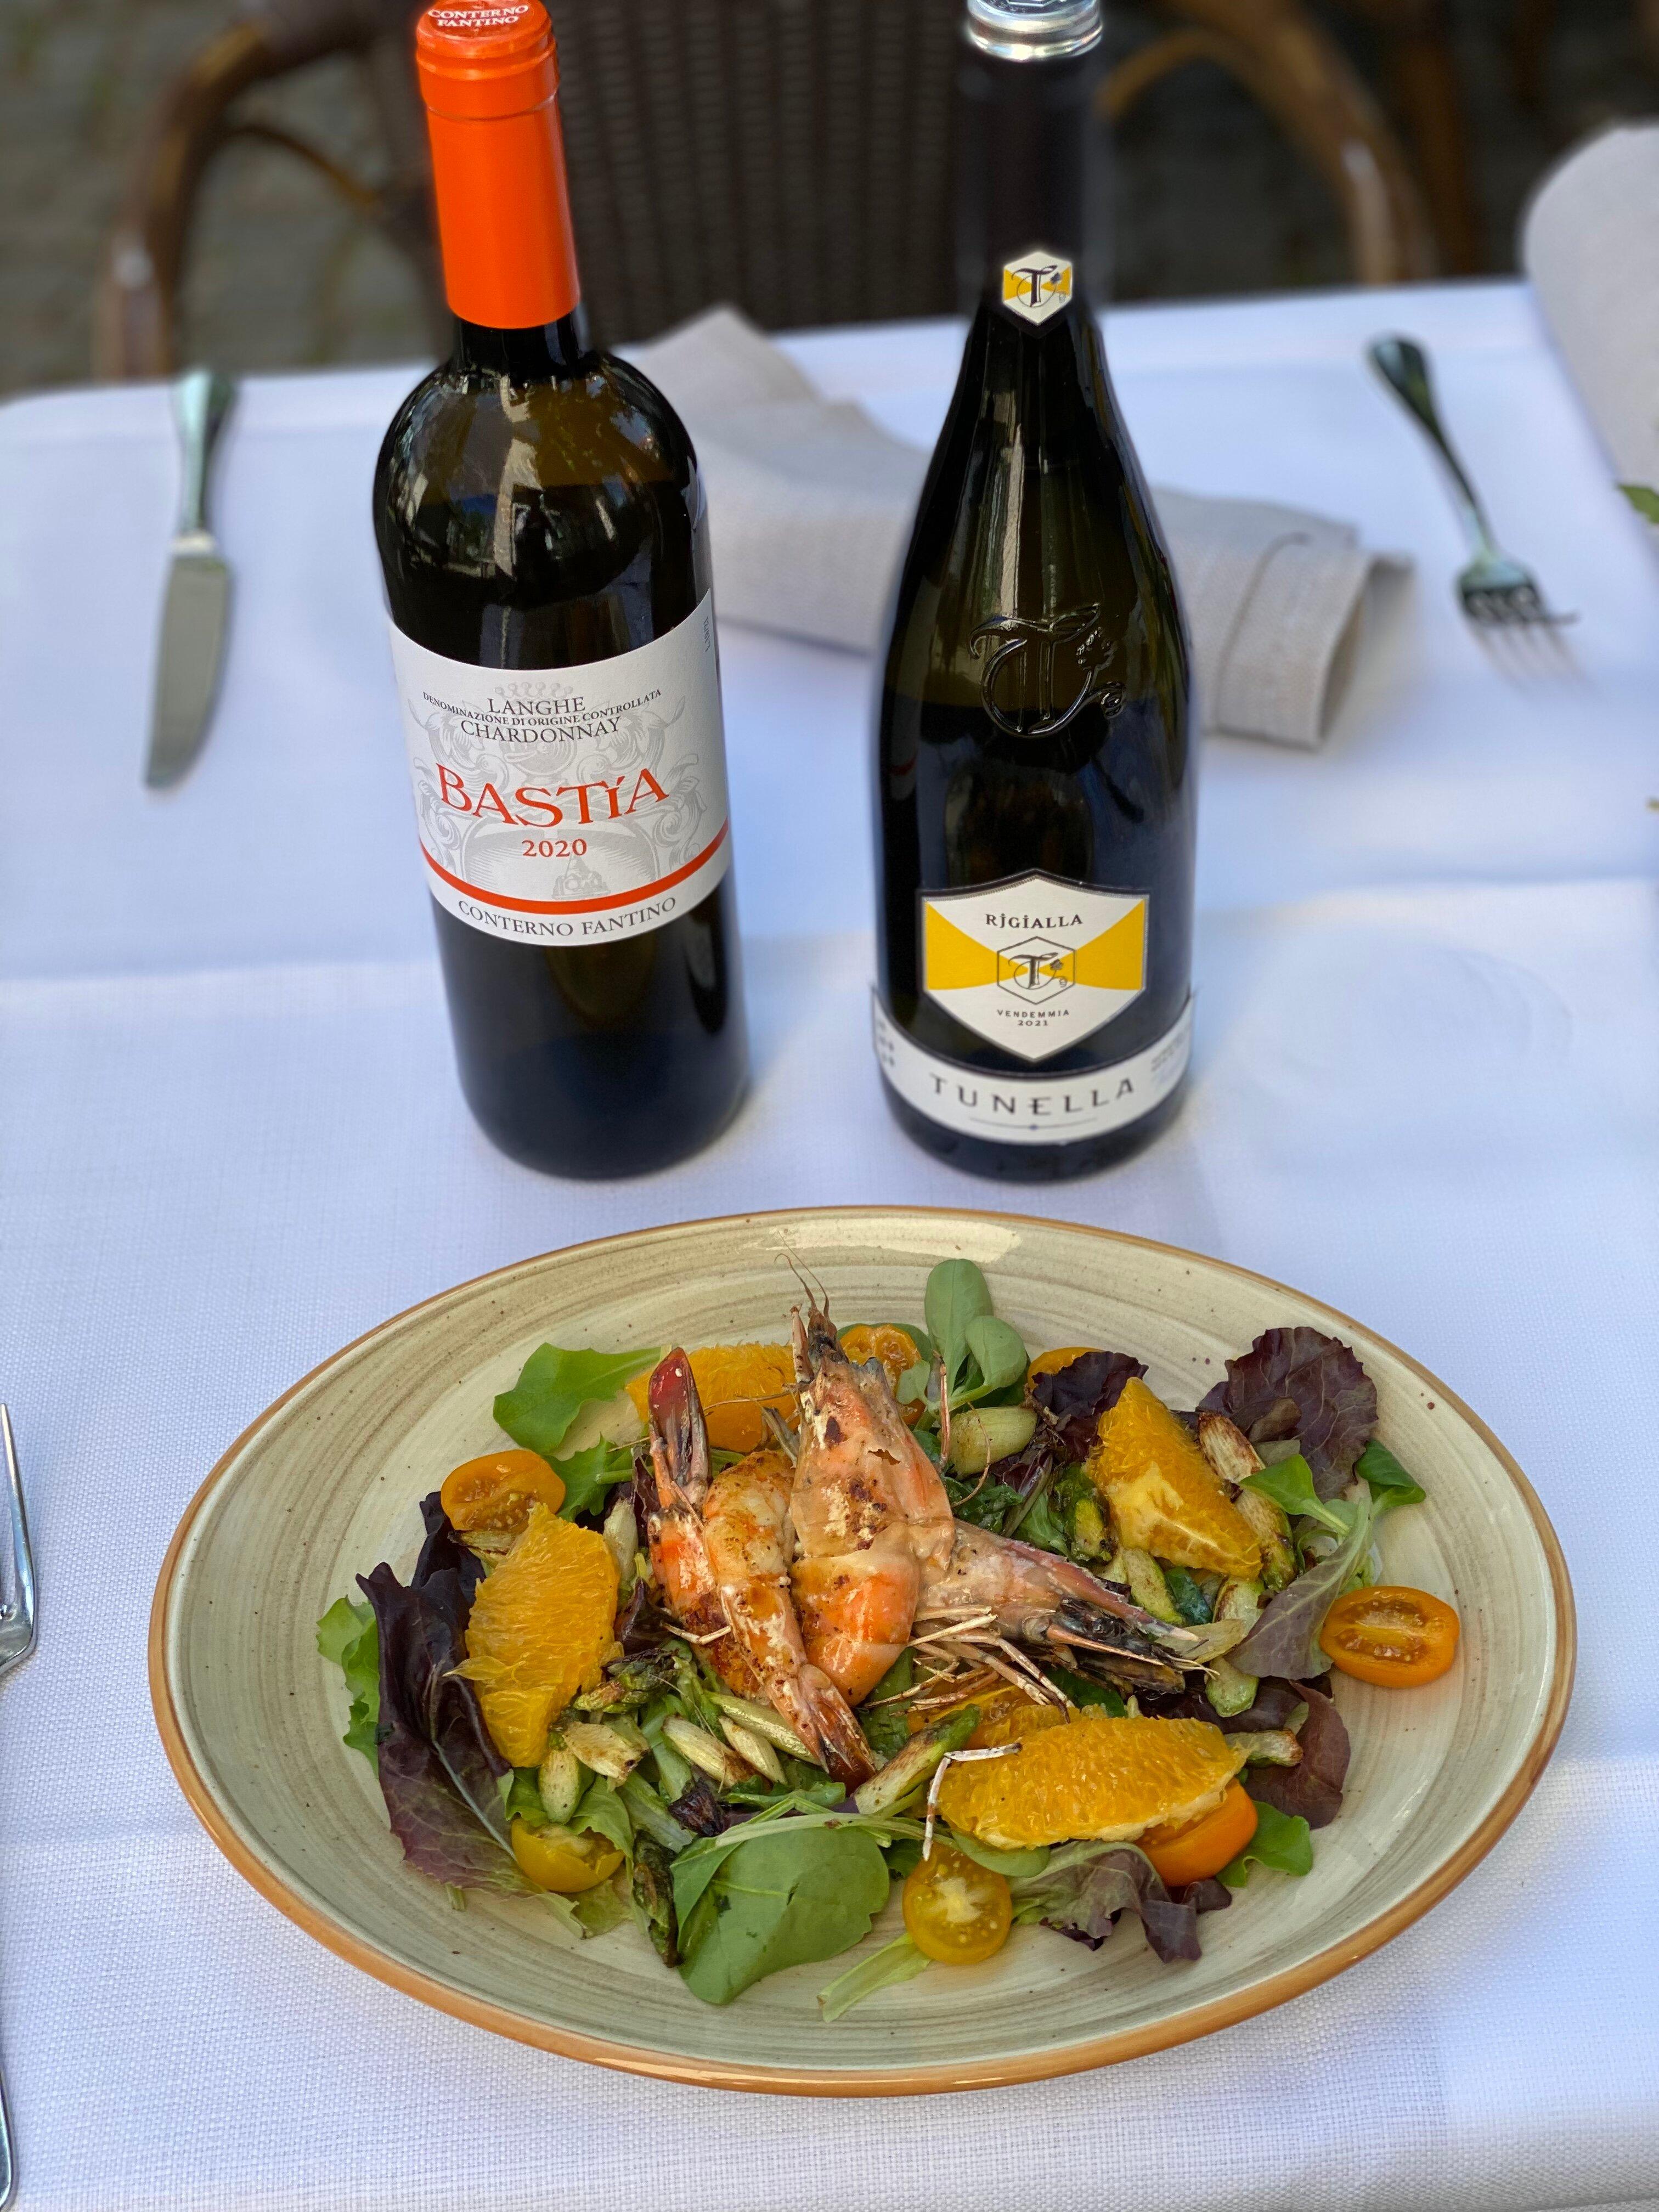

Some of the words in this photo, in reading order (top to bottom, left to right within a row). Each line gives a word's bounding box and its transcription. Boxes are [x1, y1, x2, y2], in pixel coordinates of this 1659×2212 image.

[428, 5, 529, 19] CONTERNO
[438, 15, 519, 27] FANTINO
[422, 691, 510, 724] DENOMINAZIONE
[528, 715, 580, 726] ORIGINE
[583, 689, 661, 721] CONTROLLATA
[487, 697, 585, 715] LANGHE
[461, 716, 620, 743] CHARDONNAY
[522, 839, 588, 857] 2020
[458, 901, 573, 936] CONTERNO
[582, 898, 676, 935] FANTINO
[997, 1009, 1069, 1018] VENDEMMIA
[929, 1073, 1135, 1115] TUNELLA
